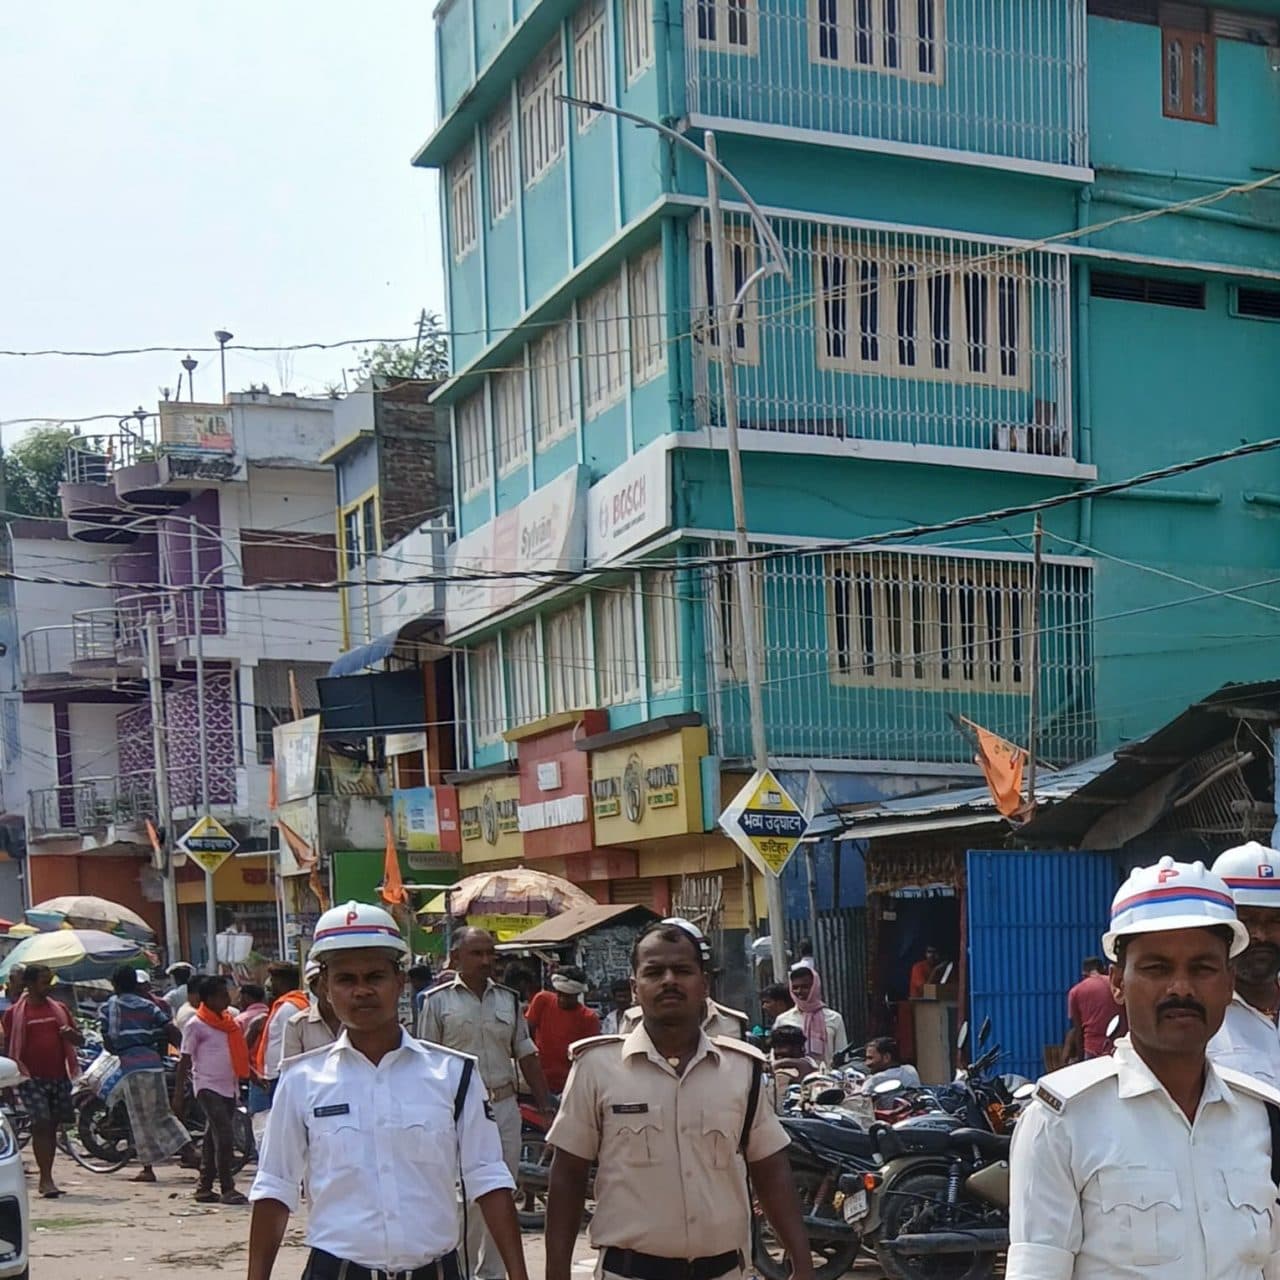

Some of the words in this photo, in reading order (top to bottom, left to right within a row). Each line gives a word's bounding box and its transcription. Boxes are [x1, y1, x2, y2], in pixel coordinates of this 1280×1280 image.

[612, 475, 647, 525] BOSCH
[743, 813, 763, 829] भव्य
[1158, 869, 1179, 884] P
[346, 911, 358, 926] P
